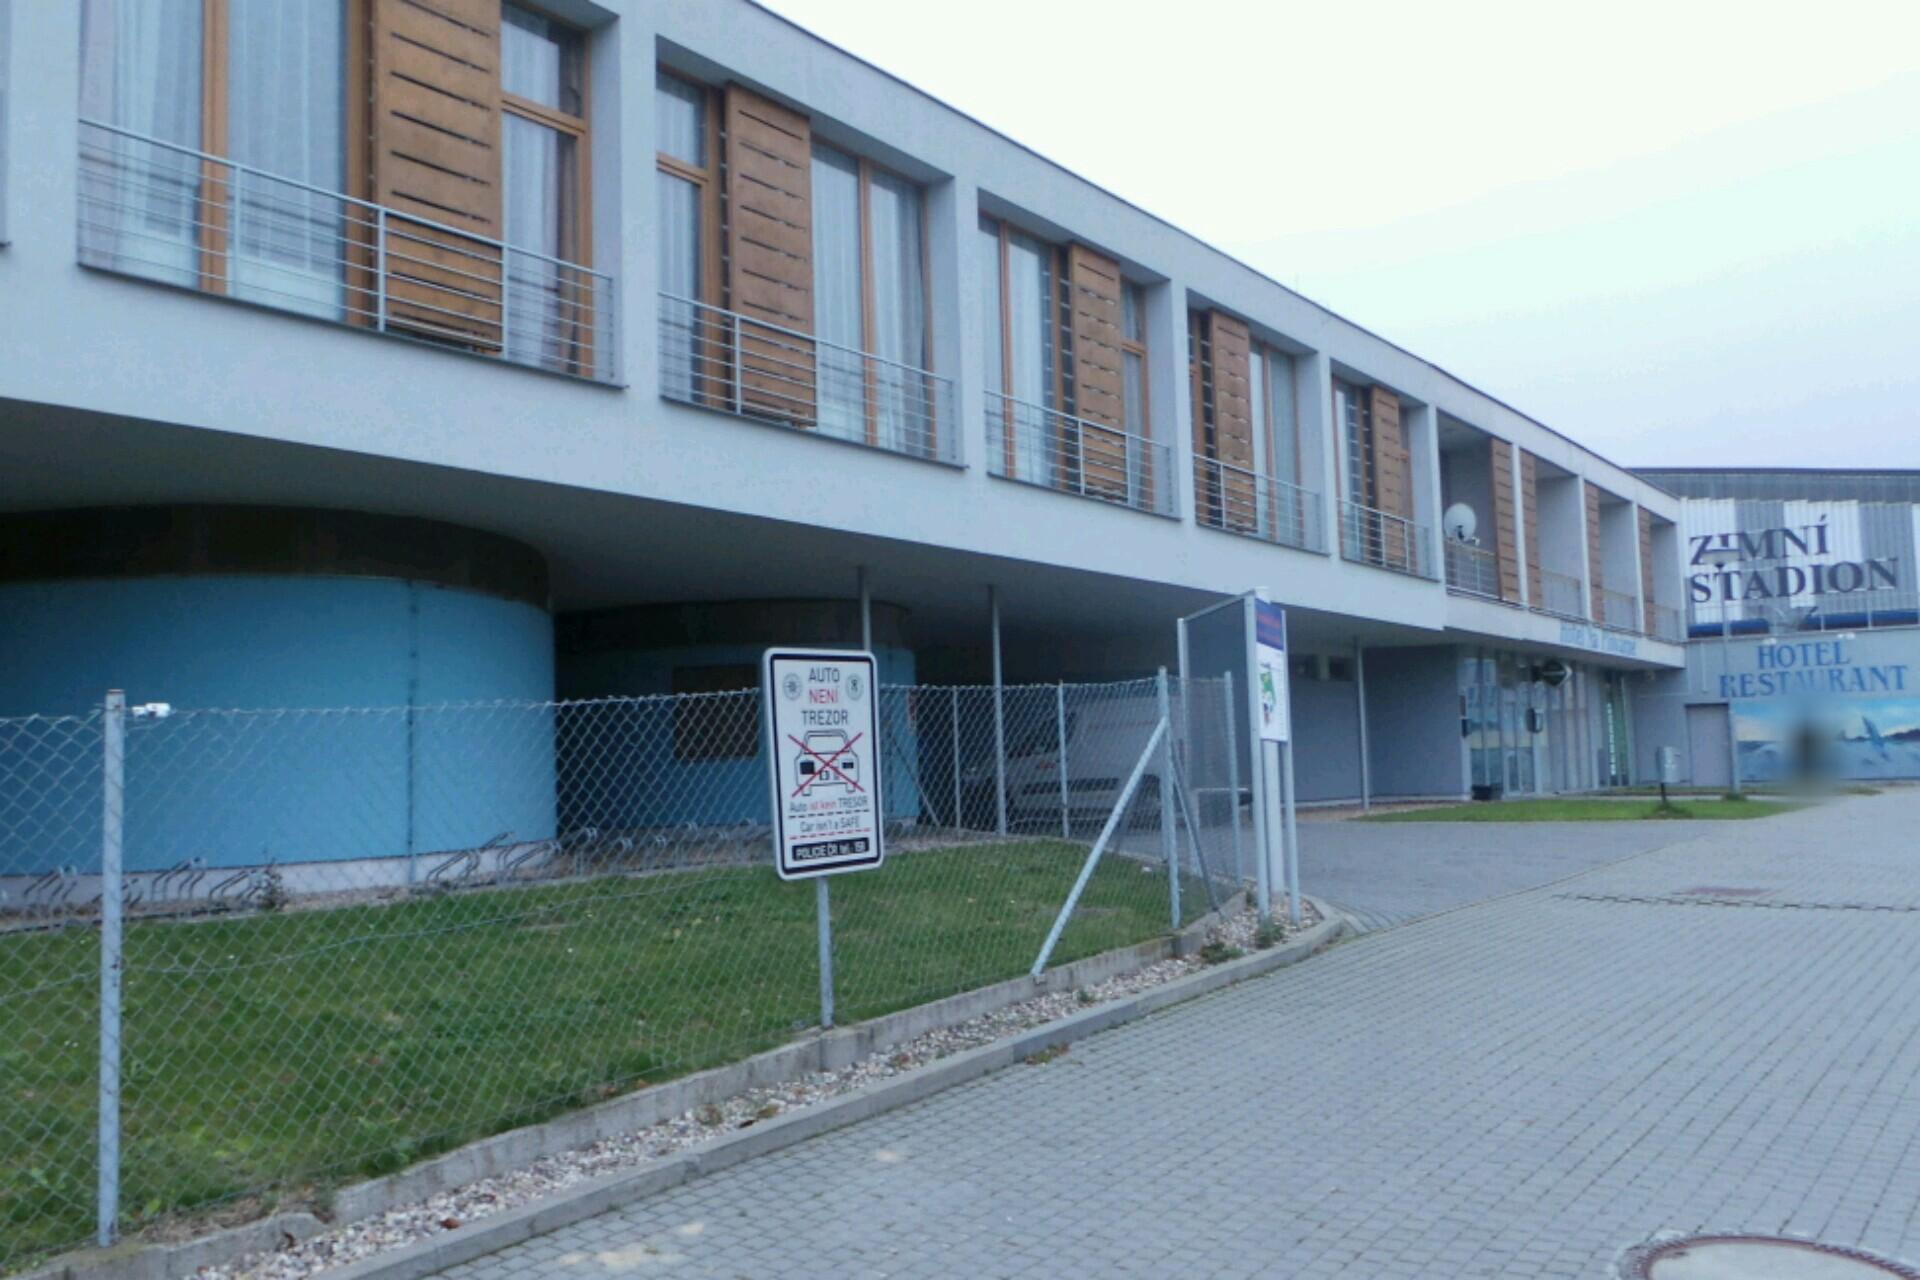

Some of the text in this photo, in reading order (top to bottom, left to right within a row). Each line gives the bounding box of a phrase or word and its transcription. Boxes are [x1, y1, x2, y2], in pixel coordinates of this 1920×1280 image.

[1690, 557, 1899, 603] STADION
[1757, 640, 1852, 670] HOTEL
[808, 667, 840, 683] AUTO
[1720, 664, 1908, 699] RESTAURANT
[808, 686, 839, 704] NENÍ
[801, 709, 849, 726] TREZOR
[789, 800, 808, 812] Auto
[838, 795, 868, 810] TRESOR
[800, 820, 814, 832] Car
[840, 816, 860, 829] SAFE
